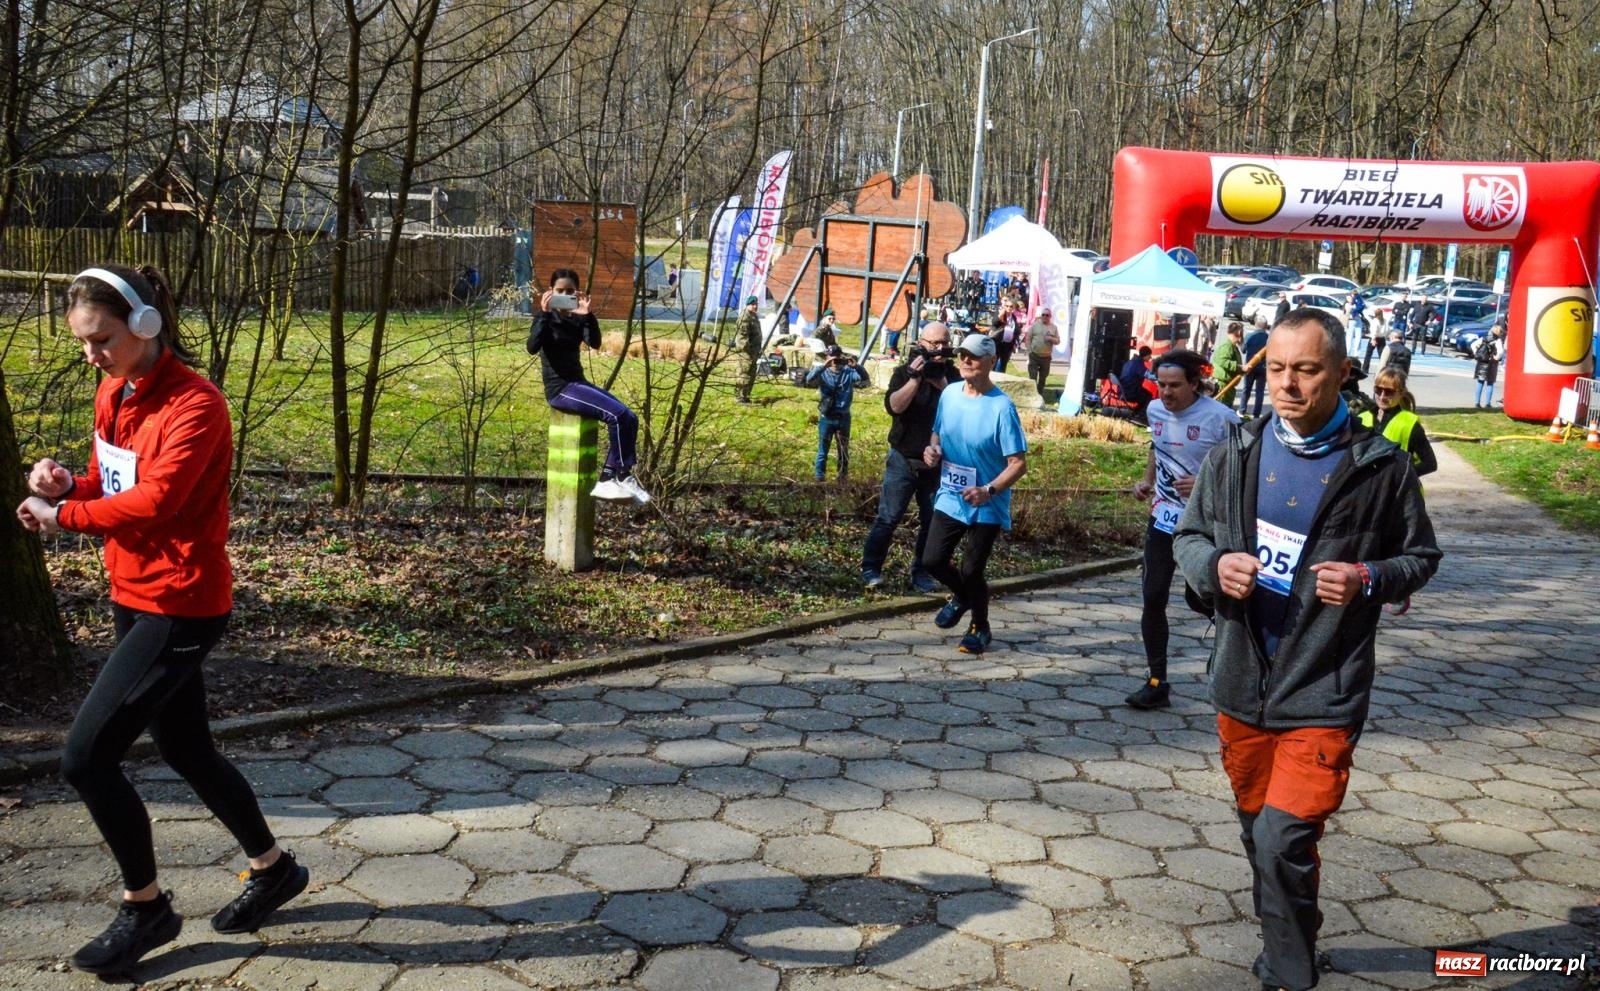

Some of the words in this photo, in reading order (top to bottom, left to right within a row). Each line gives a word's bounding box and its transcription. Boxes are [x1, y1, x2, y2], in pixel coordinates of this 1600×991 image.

[1344, 169, 1398, 183] BIEG
[1300, 188, 1443, 210] TWARDZIELA
[753, 164, 783, 276] RACIBÓRZ
[1310, 213, 1426, 231] RACIBÓRZ
[948, 472, 967, 486] 128
[1257, 545, 1296, 575] 05
